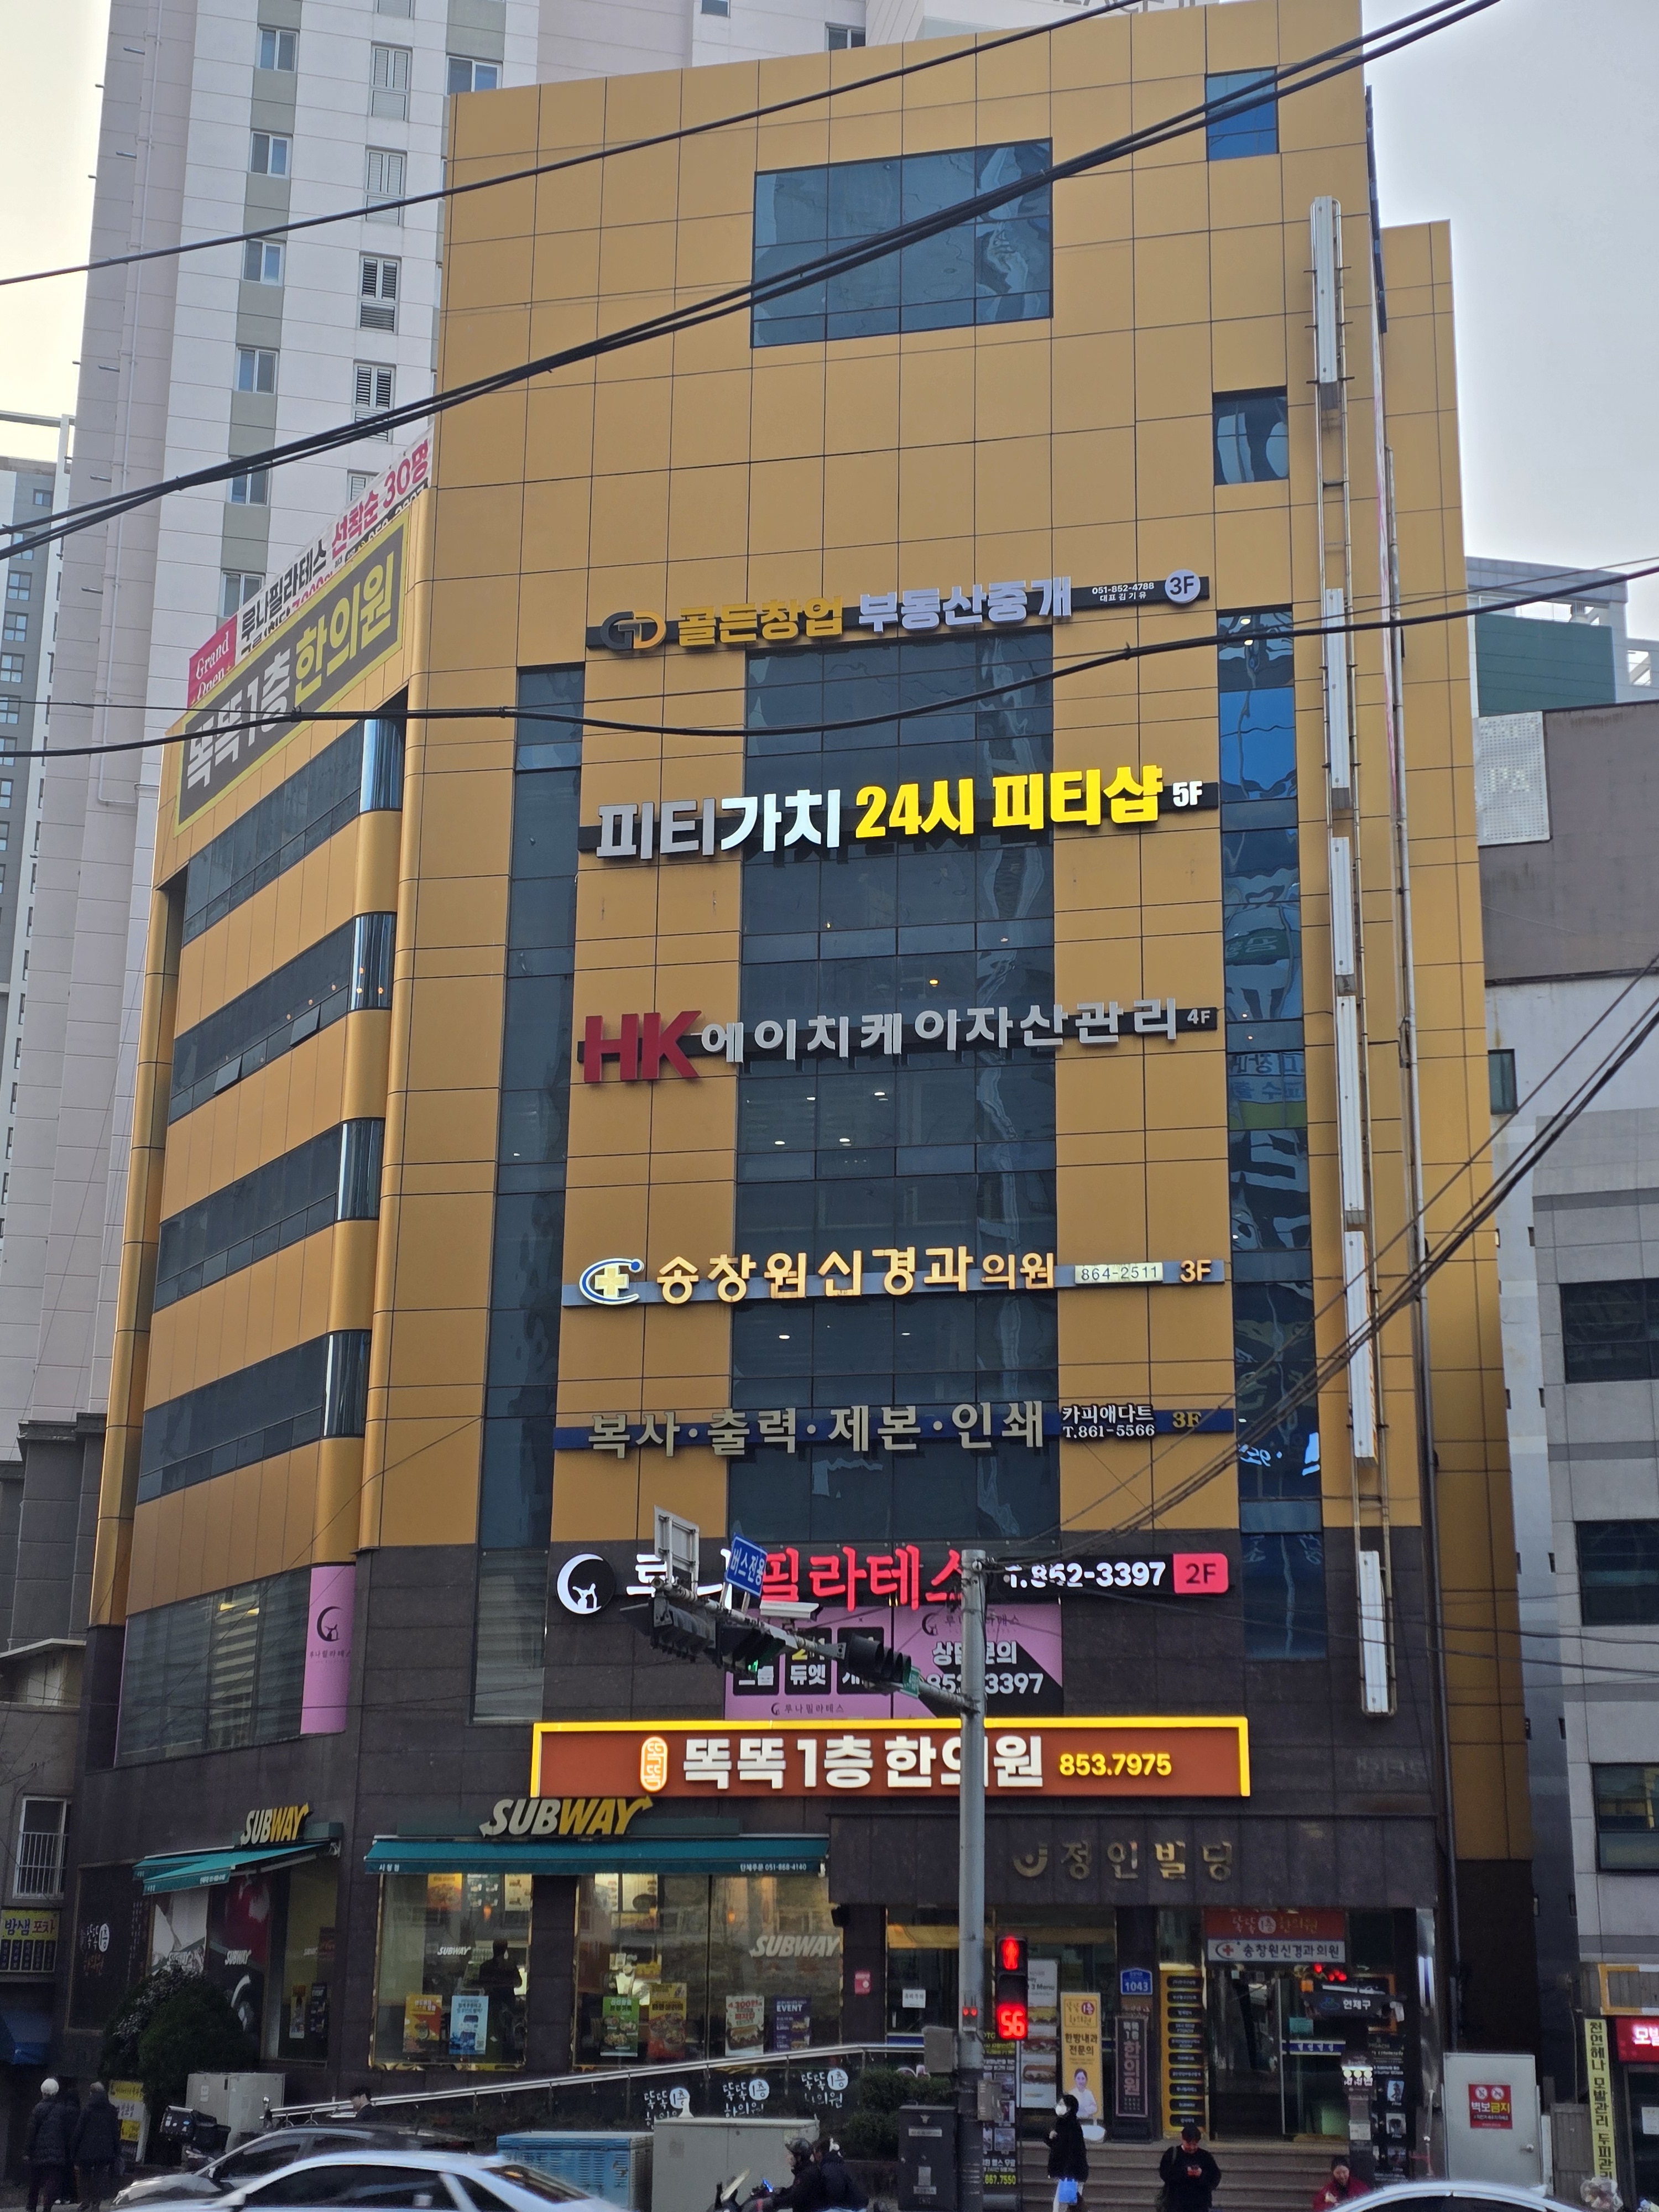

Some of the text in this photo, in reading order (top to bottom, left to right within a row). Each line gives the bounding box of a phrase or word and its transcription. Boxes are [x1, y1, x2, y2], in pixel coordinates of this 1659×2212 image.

[241, 539, 326, 642] 루나필라테스
[332, 490, 379, 560] 선착순
[383, 438, 429, 509] 30명
[1092, 582, 1155, 596] 051-852-4788
[1170, 575, 1195, 596] 3F
[678, 576, 1072, 648] 골든창업 부동산중개
[196, 630, 229, 680] Grand
[855, 778, 974, 838] 24시
[993, 764, 1163, 830] 피티샵
[1172, 781, 1203, 807] 5F
[1187, 1009, 1211, 1024] 4F
[583, 1010, 702, 1082] HK
[1081, 1266, 1159, 1281] 864-2511
[1180, 1259, 1212, 1283] 3F
[1063, 1424, 1155, 1439] T.861-5566
[730, 1547, 765, 1586] 버스전용
[1186, 1563, 1217, 1584] 2F
[790, 1664, 826, 1685] 듀엣
[1060, 1752, 1172, 1776] 853.7975
[240, 1802, 309, 1846] SUBWAY
[479, 1796, 653, 1838] SUBWAY
[5, 1918, 55, 1936] 밤샘 포차
[437, 1947, 470, 1955] SUBWAY
[750, 1935, 842, 1958] SUBWAY
[1124, 1981, 1149, 1991] 1043
[999, 2010, 1026, 2037] 56
